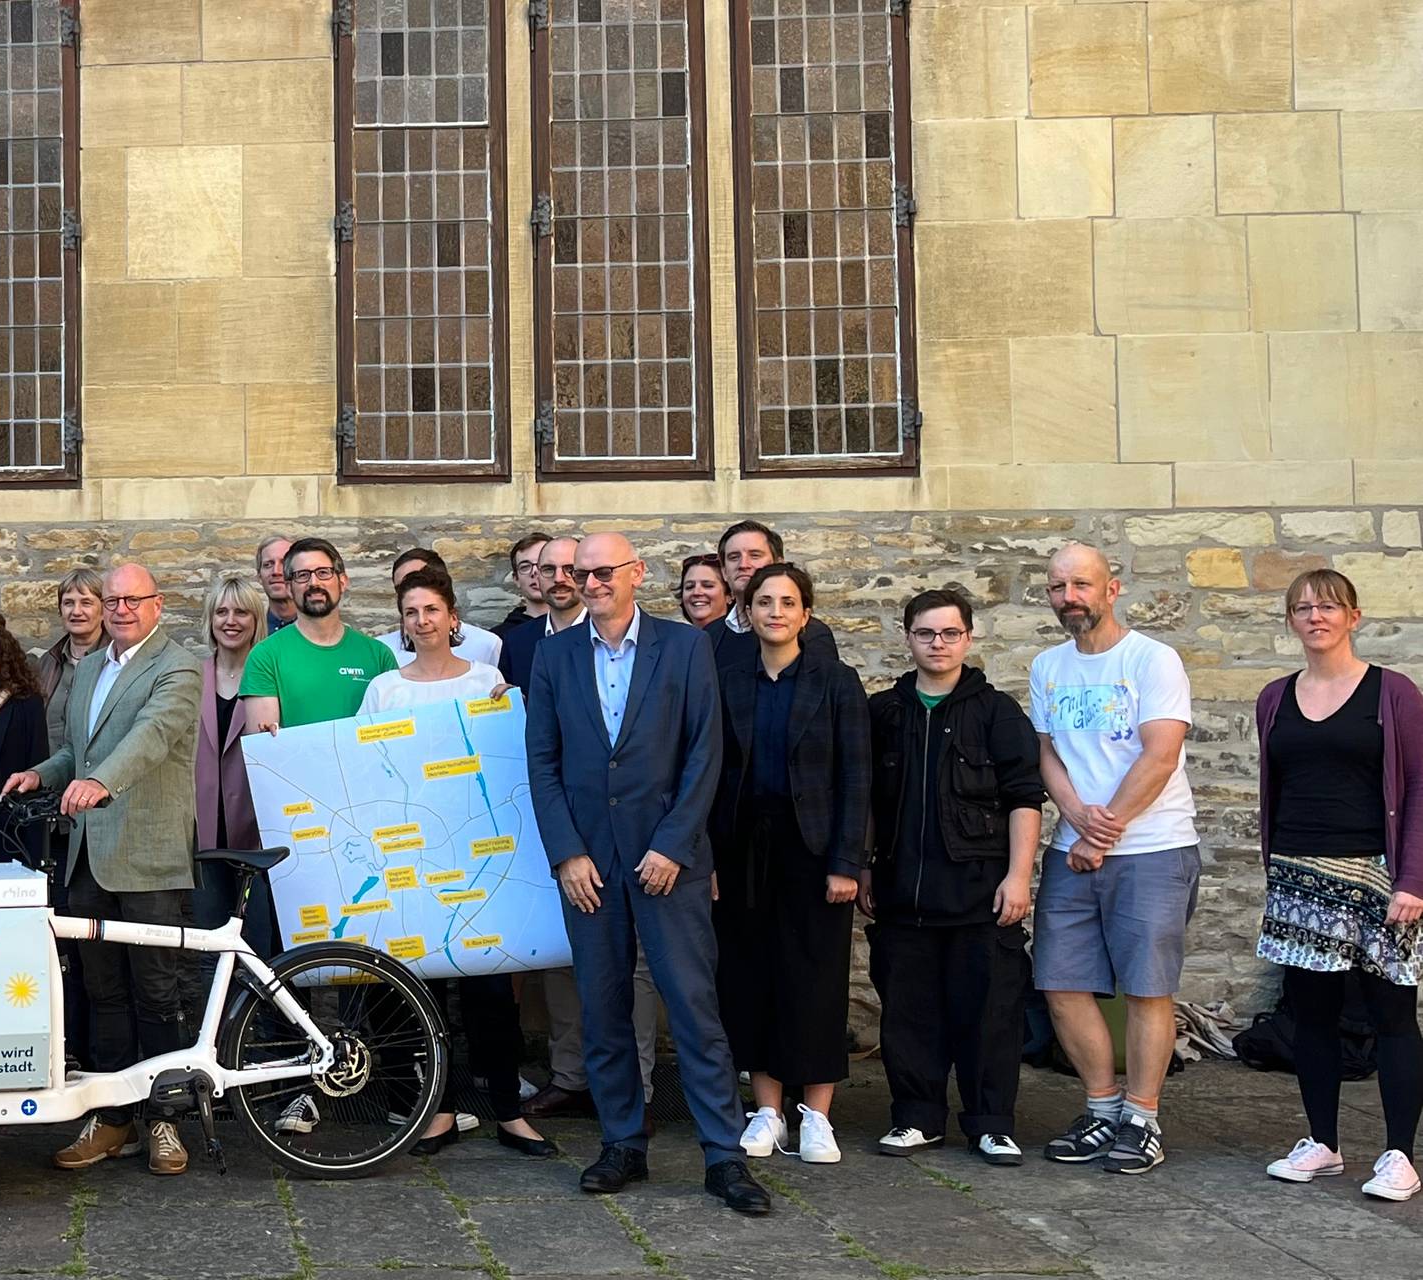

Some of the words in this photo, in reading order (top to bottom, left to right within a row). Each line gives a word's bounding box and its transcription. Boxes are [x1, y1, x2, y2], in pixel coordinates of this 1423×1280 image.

[338, 667, 365, 676] awm
[2, 886, 37, 898] rhino
[1, 1046, 34, 1059] wird
